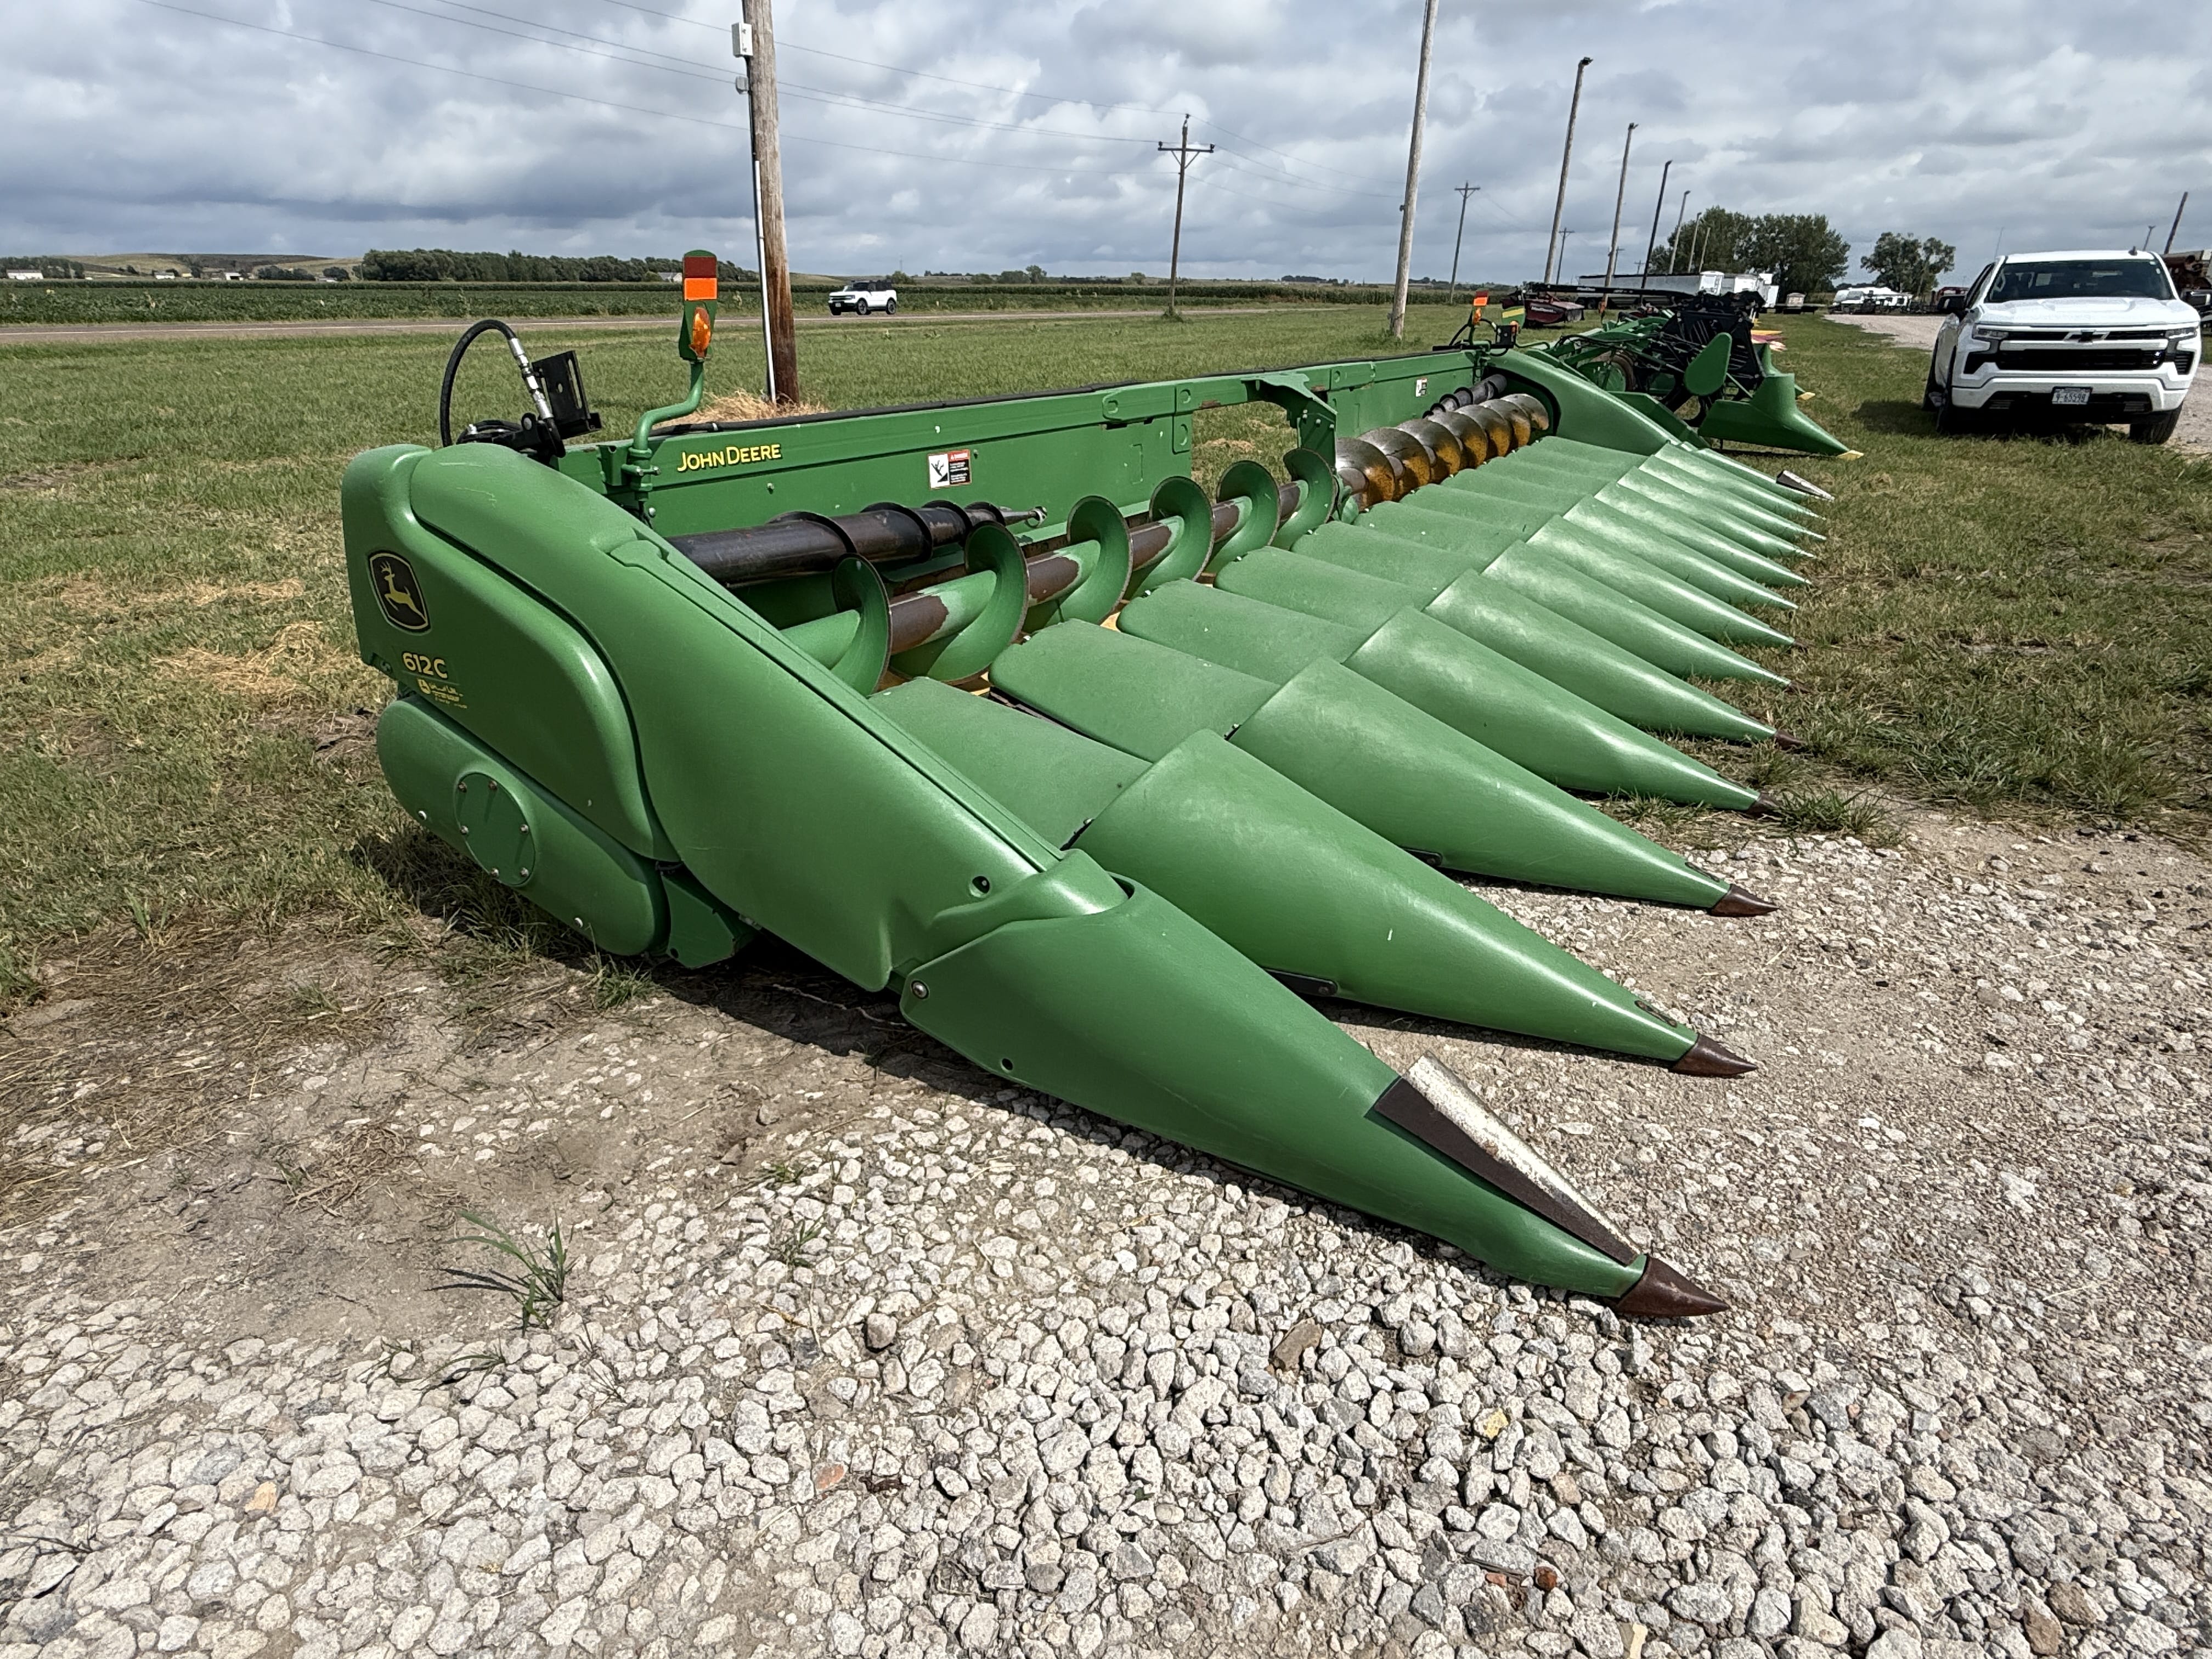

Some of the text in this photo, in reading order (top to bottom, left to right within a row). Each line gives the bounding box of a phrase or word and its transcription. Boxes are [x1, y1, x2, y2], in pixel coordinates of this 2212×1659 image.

[677, 444, 781, 472] JOHN DEERE
[402, 652, 448, 679] 612C
